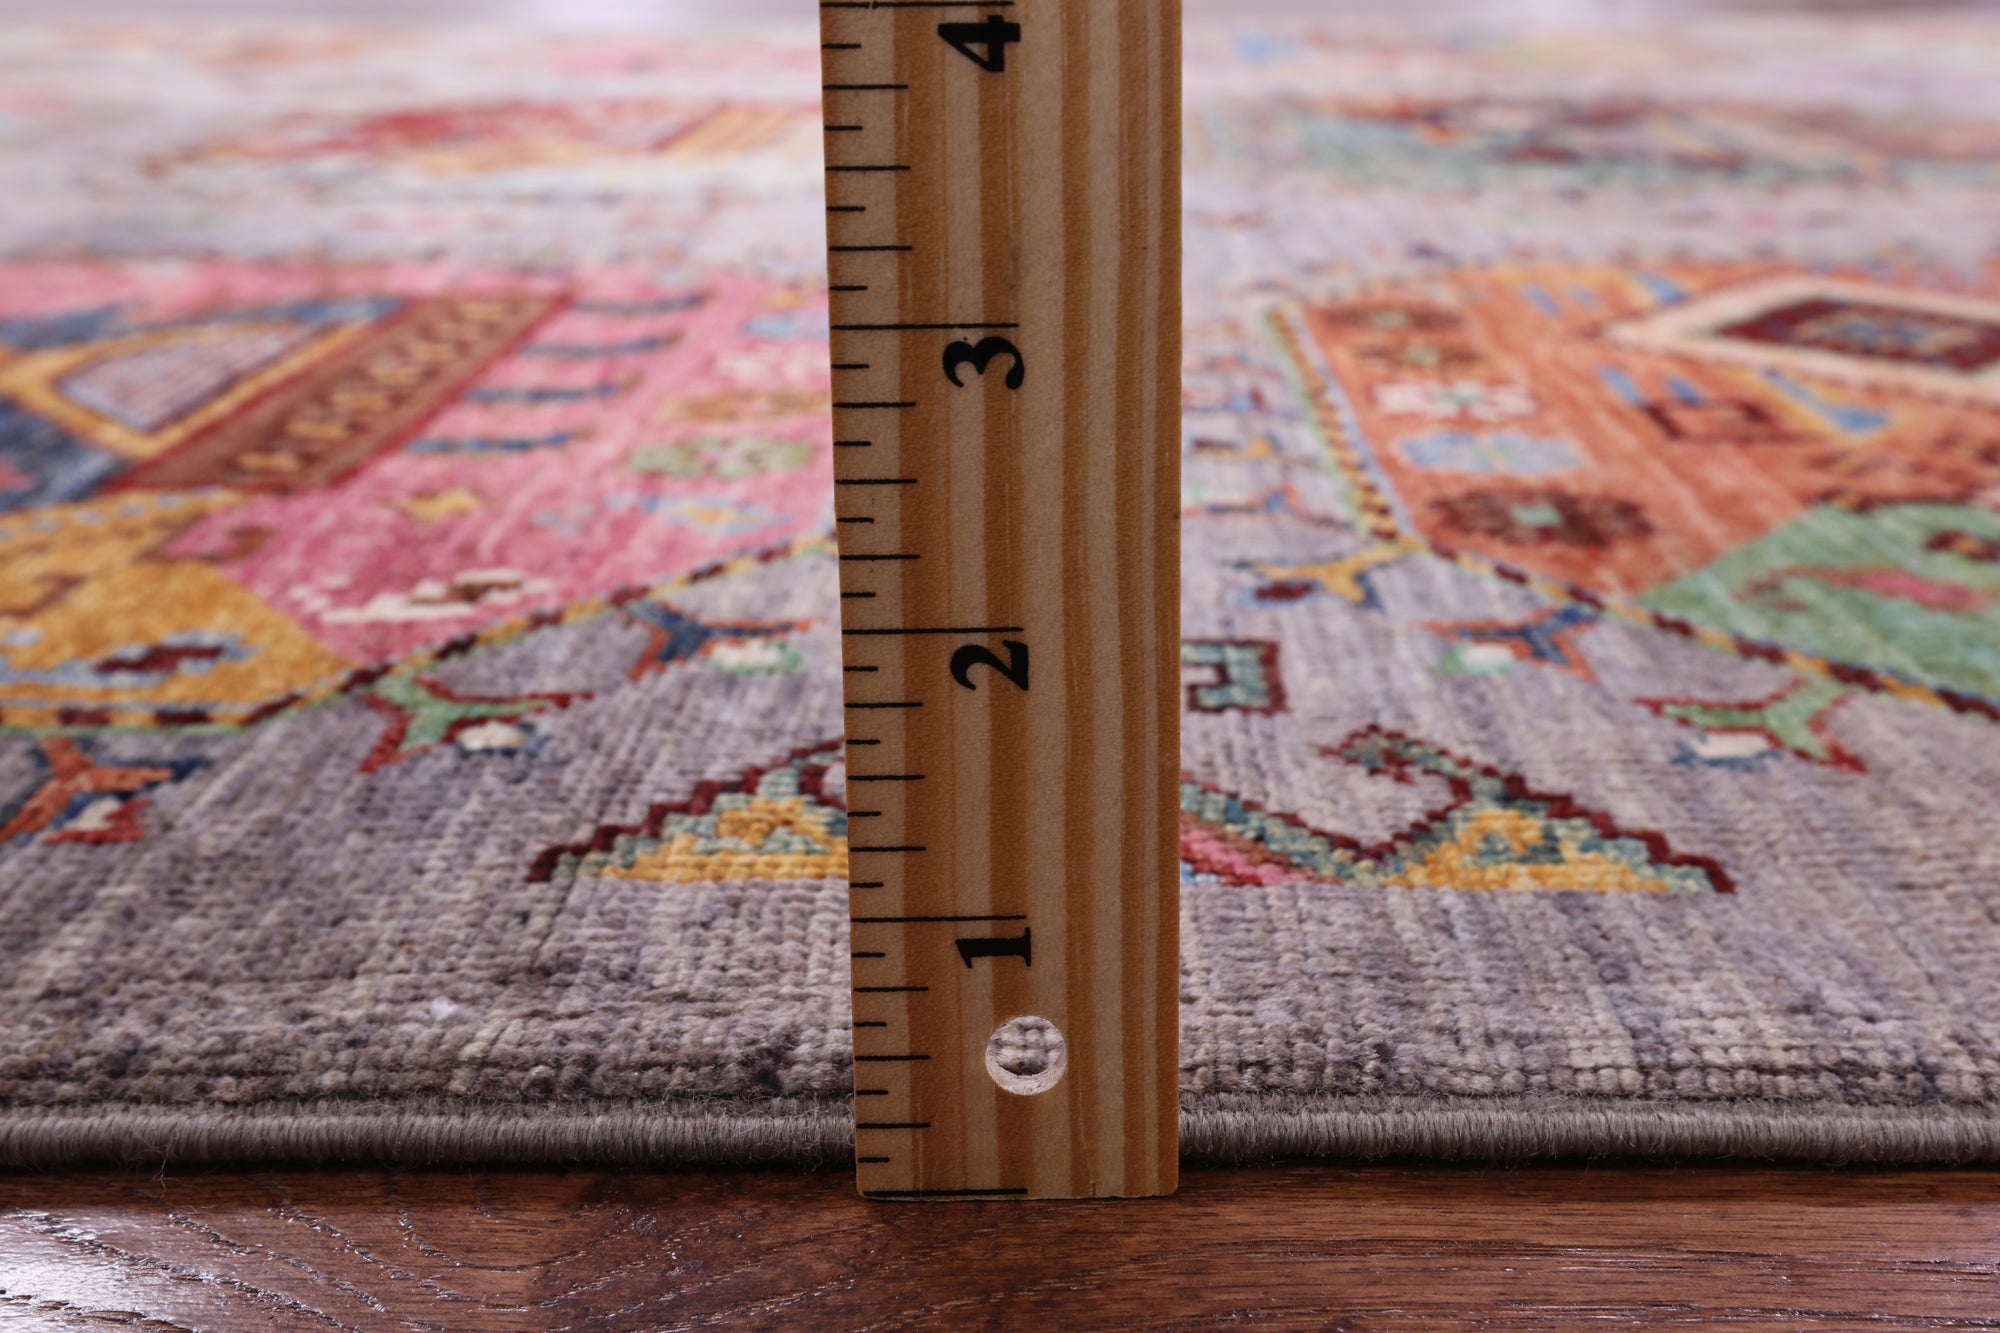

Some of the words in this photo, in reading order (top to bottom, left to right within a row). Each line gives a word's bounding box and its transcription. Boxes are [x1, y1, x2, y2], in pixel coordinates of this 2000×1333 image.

[937, 14, 1021, 73] 4
[942, 335, 1025, 390] 3
[949, 638, 1029, 692] 2
[954, 926, 1032, 969] 1
